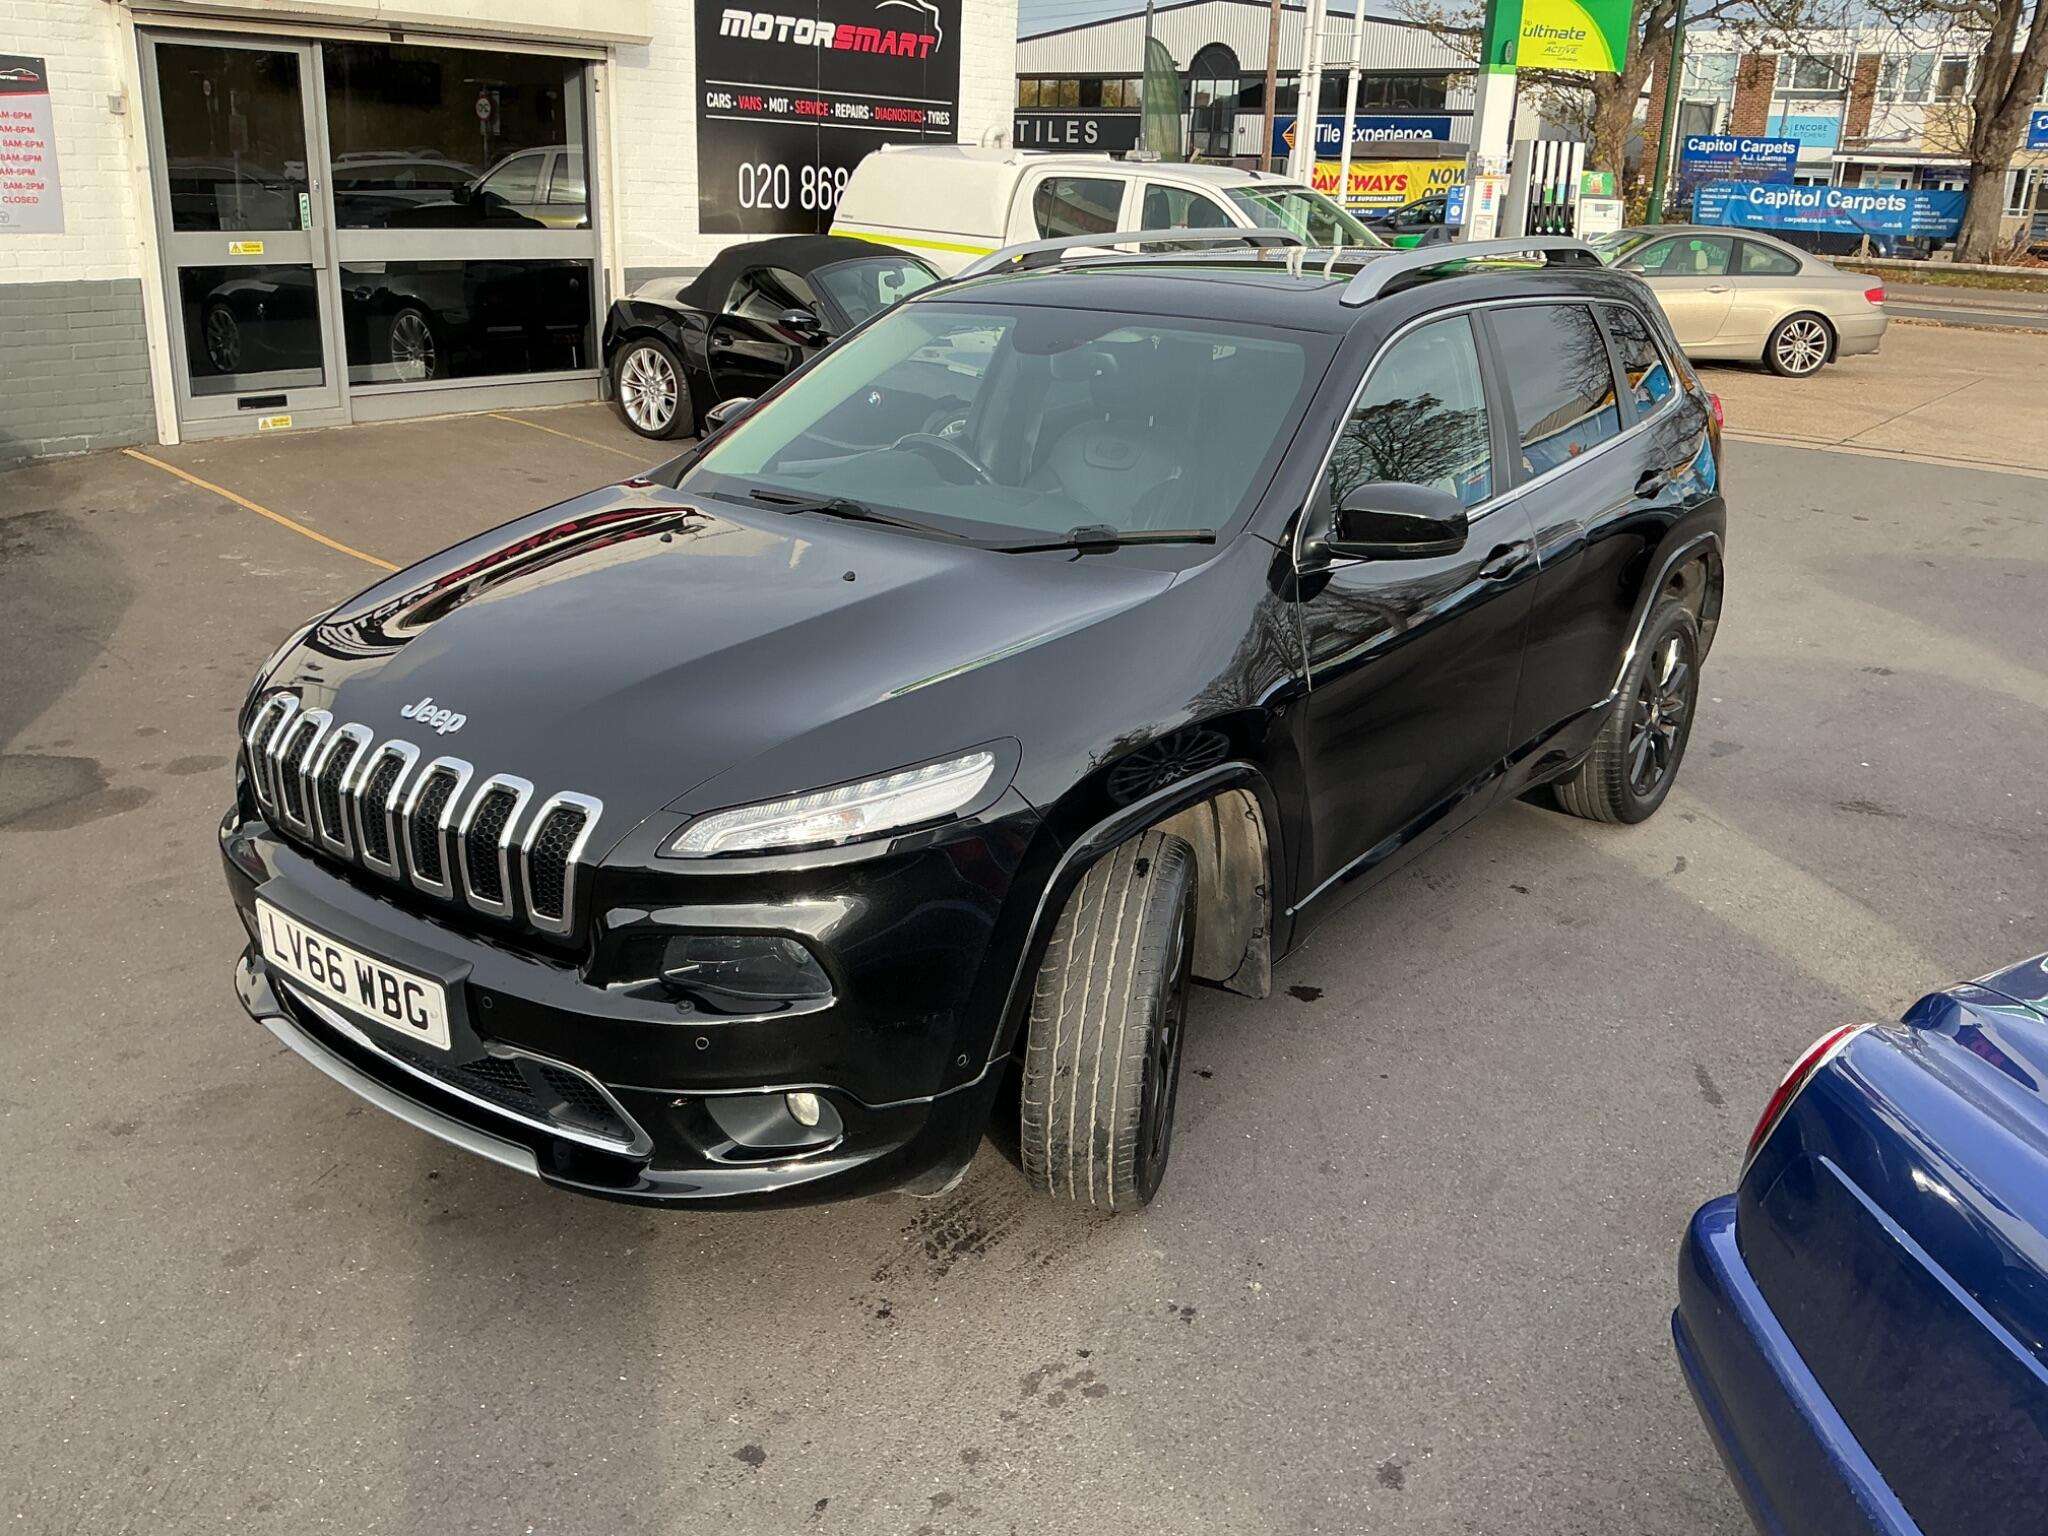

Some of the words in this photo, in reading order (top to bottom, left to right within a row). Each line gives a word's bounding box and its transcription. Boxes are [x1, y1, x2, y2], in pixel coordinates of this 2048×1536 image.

[719, 8, 936, 59] MOTORSMART
[1522, 24, 1587, 40] ultimate
[1545, 46, 1578, 55] ACTIVE
[706, 92, 732, 109] CARS
[738, 95, 763, 111] VANS
[769, 97, 789, 113] MOT
[795, 99, 829, 117] SERVICE
[835, 102, 870, 120] REPAIRS
[875, 106, 923, 123] DIAGNOSTICS
[927, 110, 950, 126] TYRES
[1016, 120, 1099, 144] TILES
[1316, 123, 1341, 143] Tile
[1688, 138, 1737, 154] Capitol
[1740, 140, 1796, 155] Carpets
[738, 162, 790, 209] 020
[2, 196, 39, 204] CLOSED
[1750, 187, 1821, 208] Capitol
[1826, 191, 1907, 213] Carpets
[400, 697, 467, 736] Jeep
[268, 912, 347, 995] LV66
[354, 959, 429, 1031] WBG
